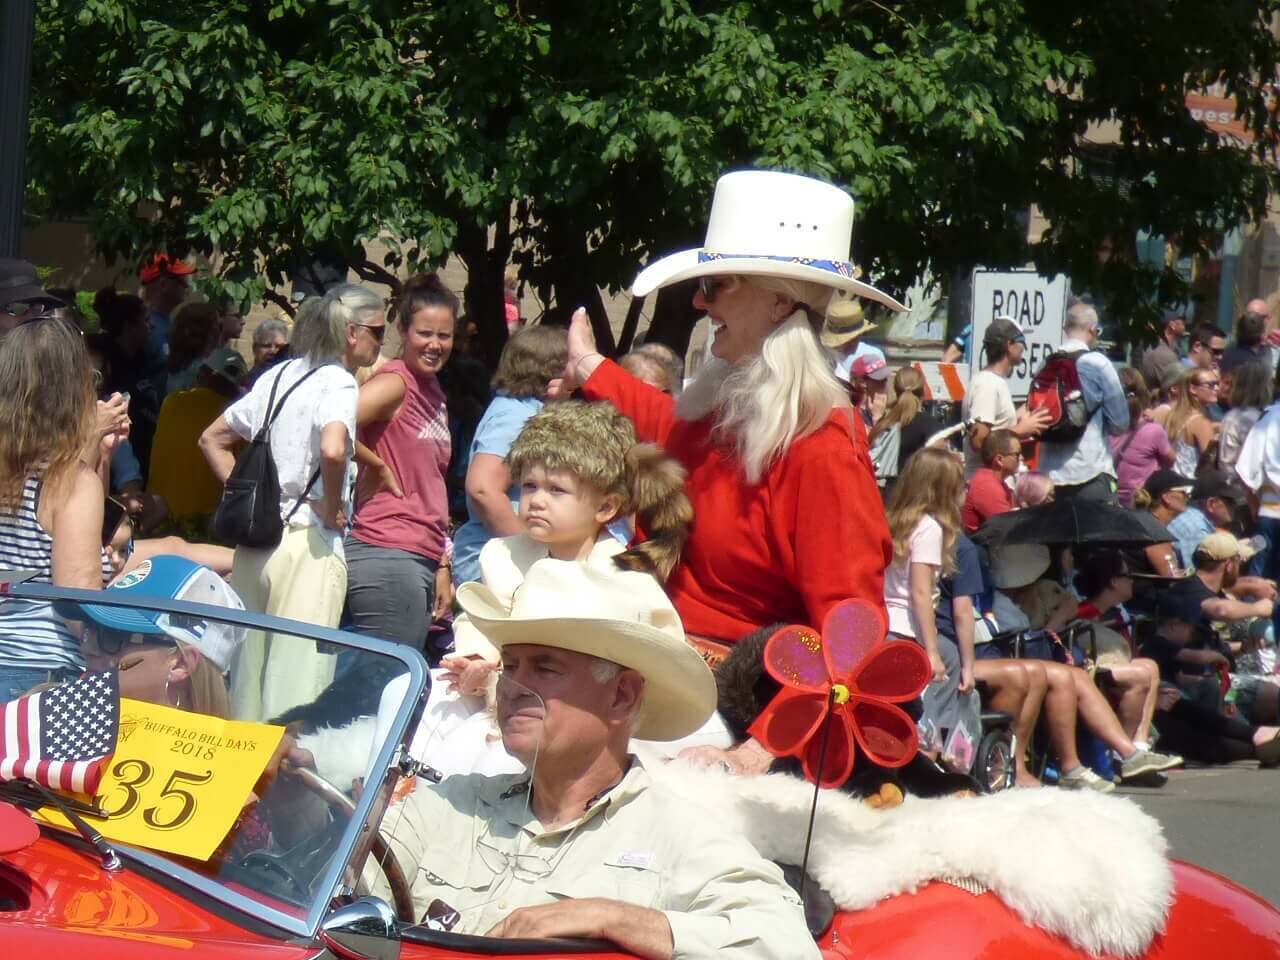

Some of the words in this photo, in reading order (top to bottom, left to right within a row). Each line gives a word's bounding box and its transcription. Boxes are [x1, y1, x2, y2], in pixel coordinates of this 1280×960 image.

[992, 290, 1045, 326] ROAD
[143, 720, 198, 741] BUFFALO
[199, 732, 224, 748] BILL
[225, 738, 258, 752] DAYS
[169, 739, 217, 761] 2018
[95, 758, 214, 832] 35
